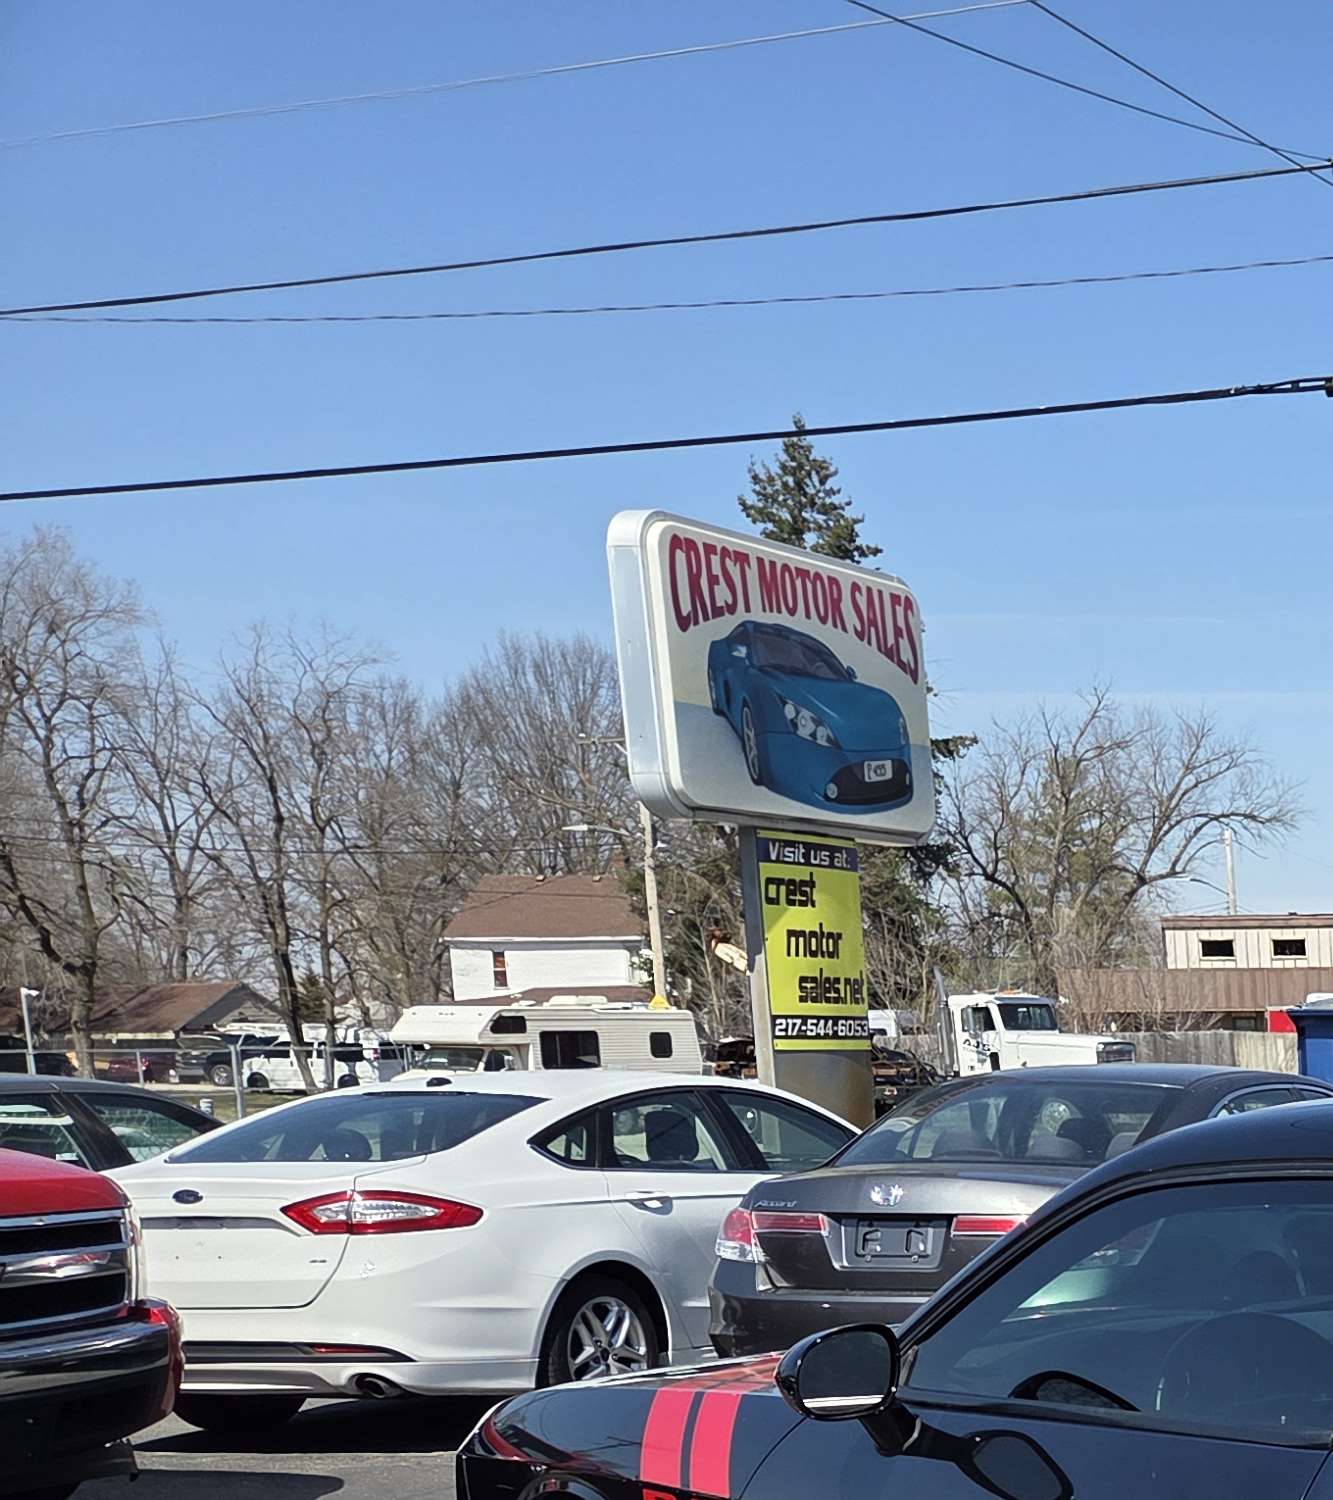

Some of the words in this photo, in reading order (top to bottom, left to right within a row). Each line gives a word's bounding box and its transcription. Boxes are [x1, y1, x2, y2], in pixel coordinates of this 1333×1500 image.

[669, 533, 751, 633] CREST
[756, 556, 848, 633] MOTOR
[850, 580, 919, 685] SALES
[769, 841, 806, 863] Visit
[810, 849, 830, 866] us
[834, 849, 851, 868] at:
[765, 871, 816, 908] crest
[786, 922, 843, 959] motor
[798, 967, 865, 1005] sales.net
[774, 1018, 869, 1037] 217-544-6053
